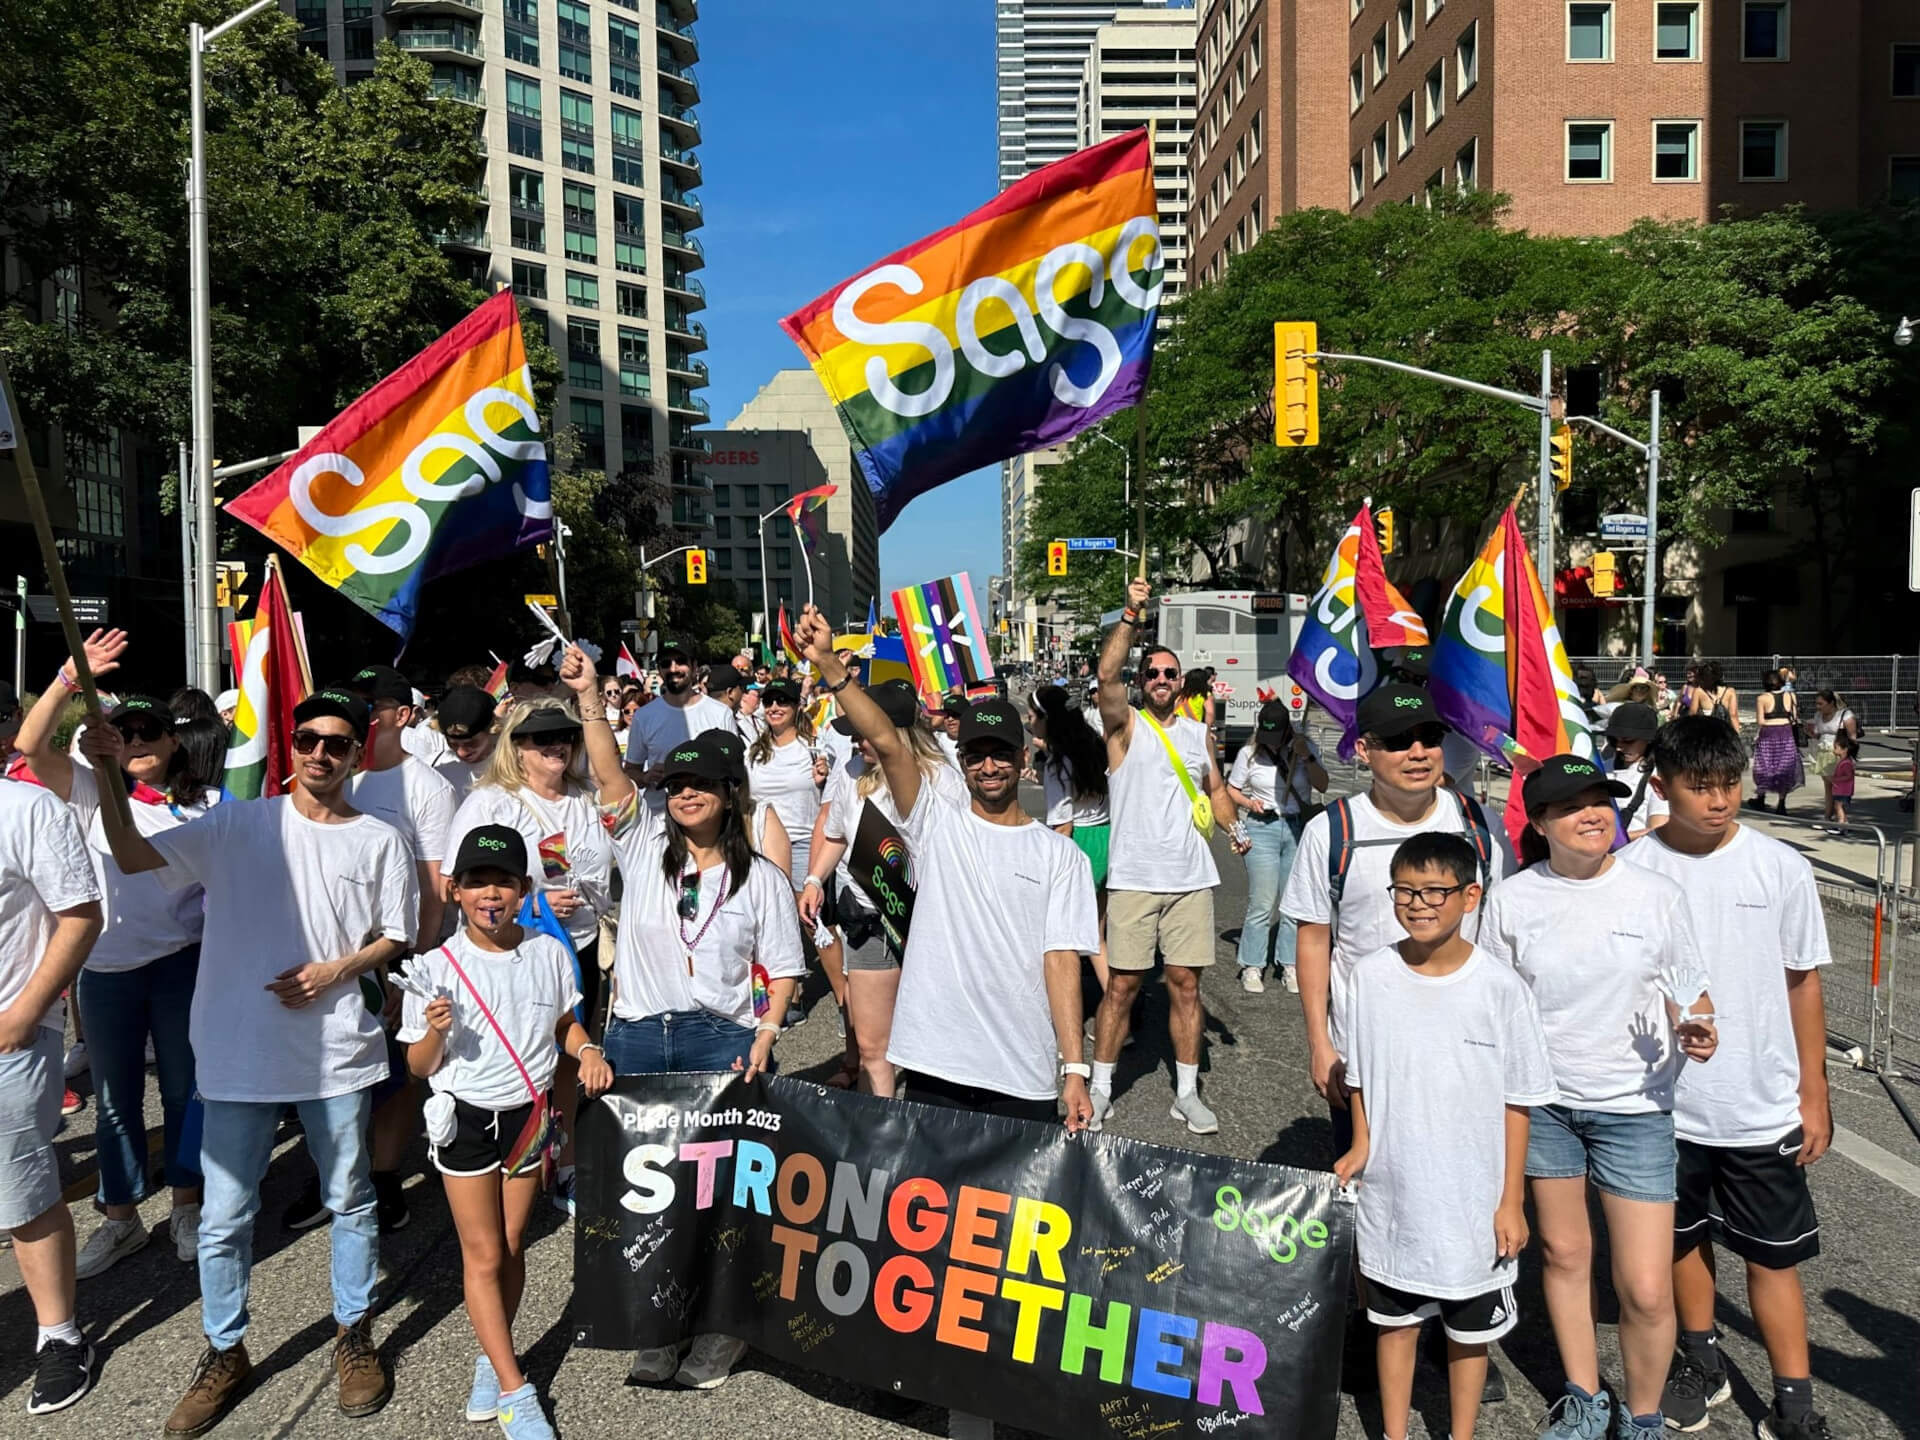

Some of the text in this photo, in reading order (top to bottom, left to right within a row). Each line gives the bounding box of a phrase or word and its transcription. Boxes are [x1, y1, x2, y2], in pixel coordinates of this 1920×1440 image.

[832, 216, 1164, 417] Sage
[289, 362, 552, 575] Sag
[976, 711, 1003, 725] Sage
[478, 836, 508, 851] Sage
[684, 1107, 743, 1128] Month
[746, 1108, 782, 1132] 2023
[619, 1139, 1073, 1285] STRONGER
[1213, 1185, 1329, 1264] Sage
[771, 1223, 1268, 1416] TOGETHER
[1099, 1396, 1130, 1417] HAPPY
